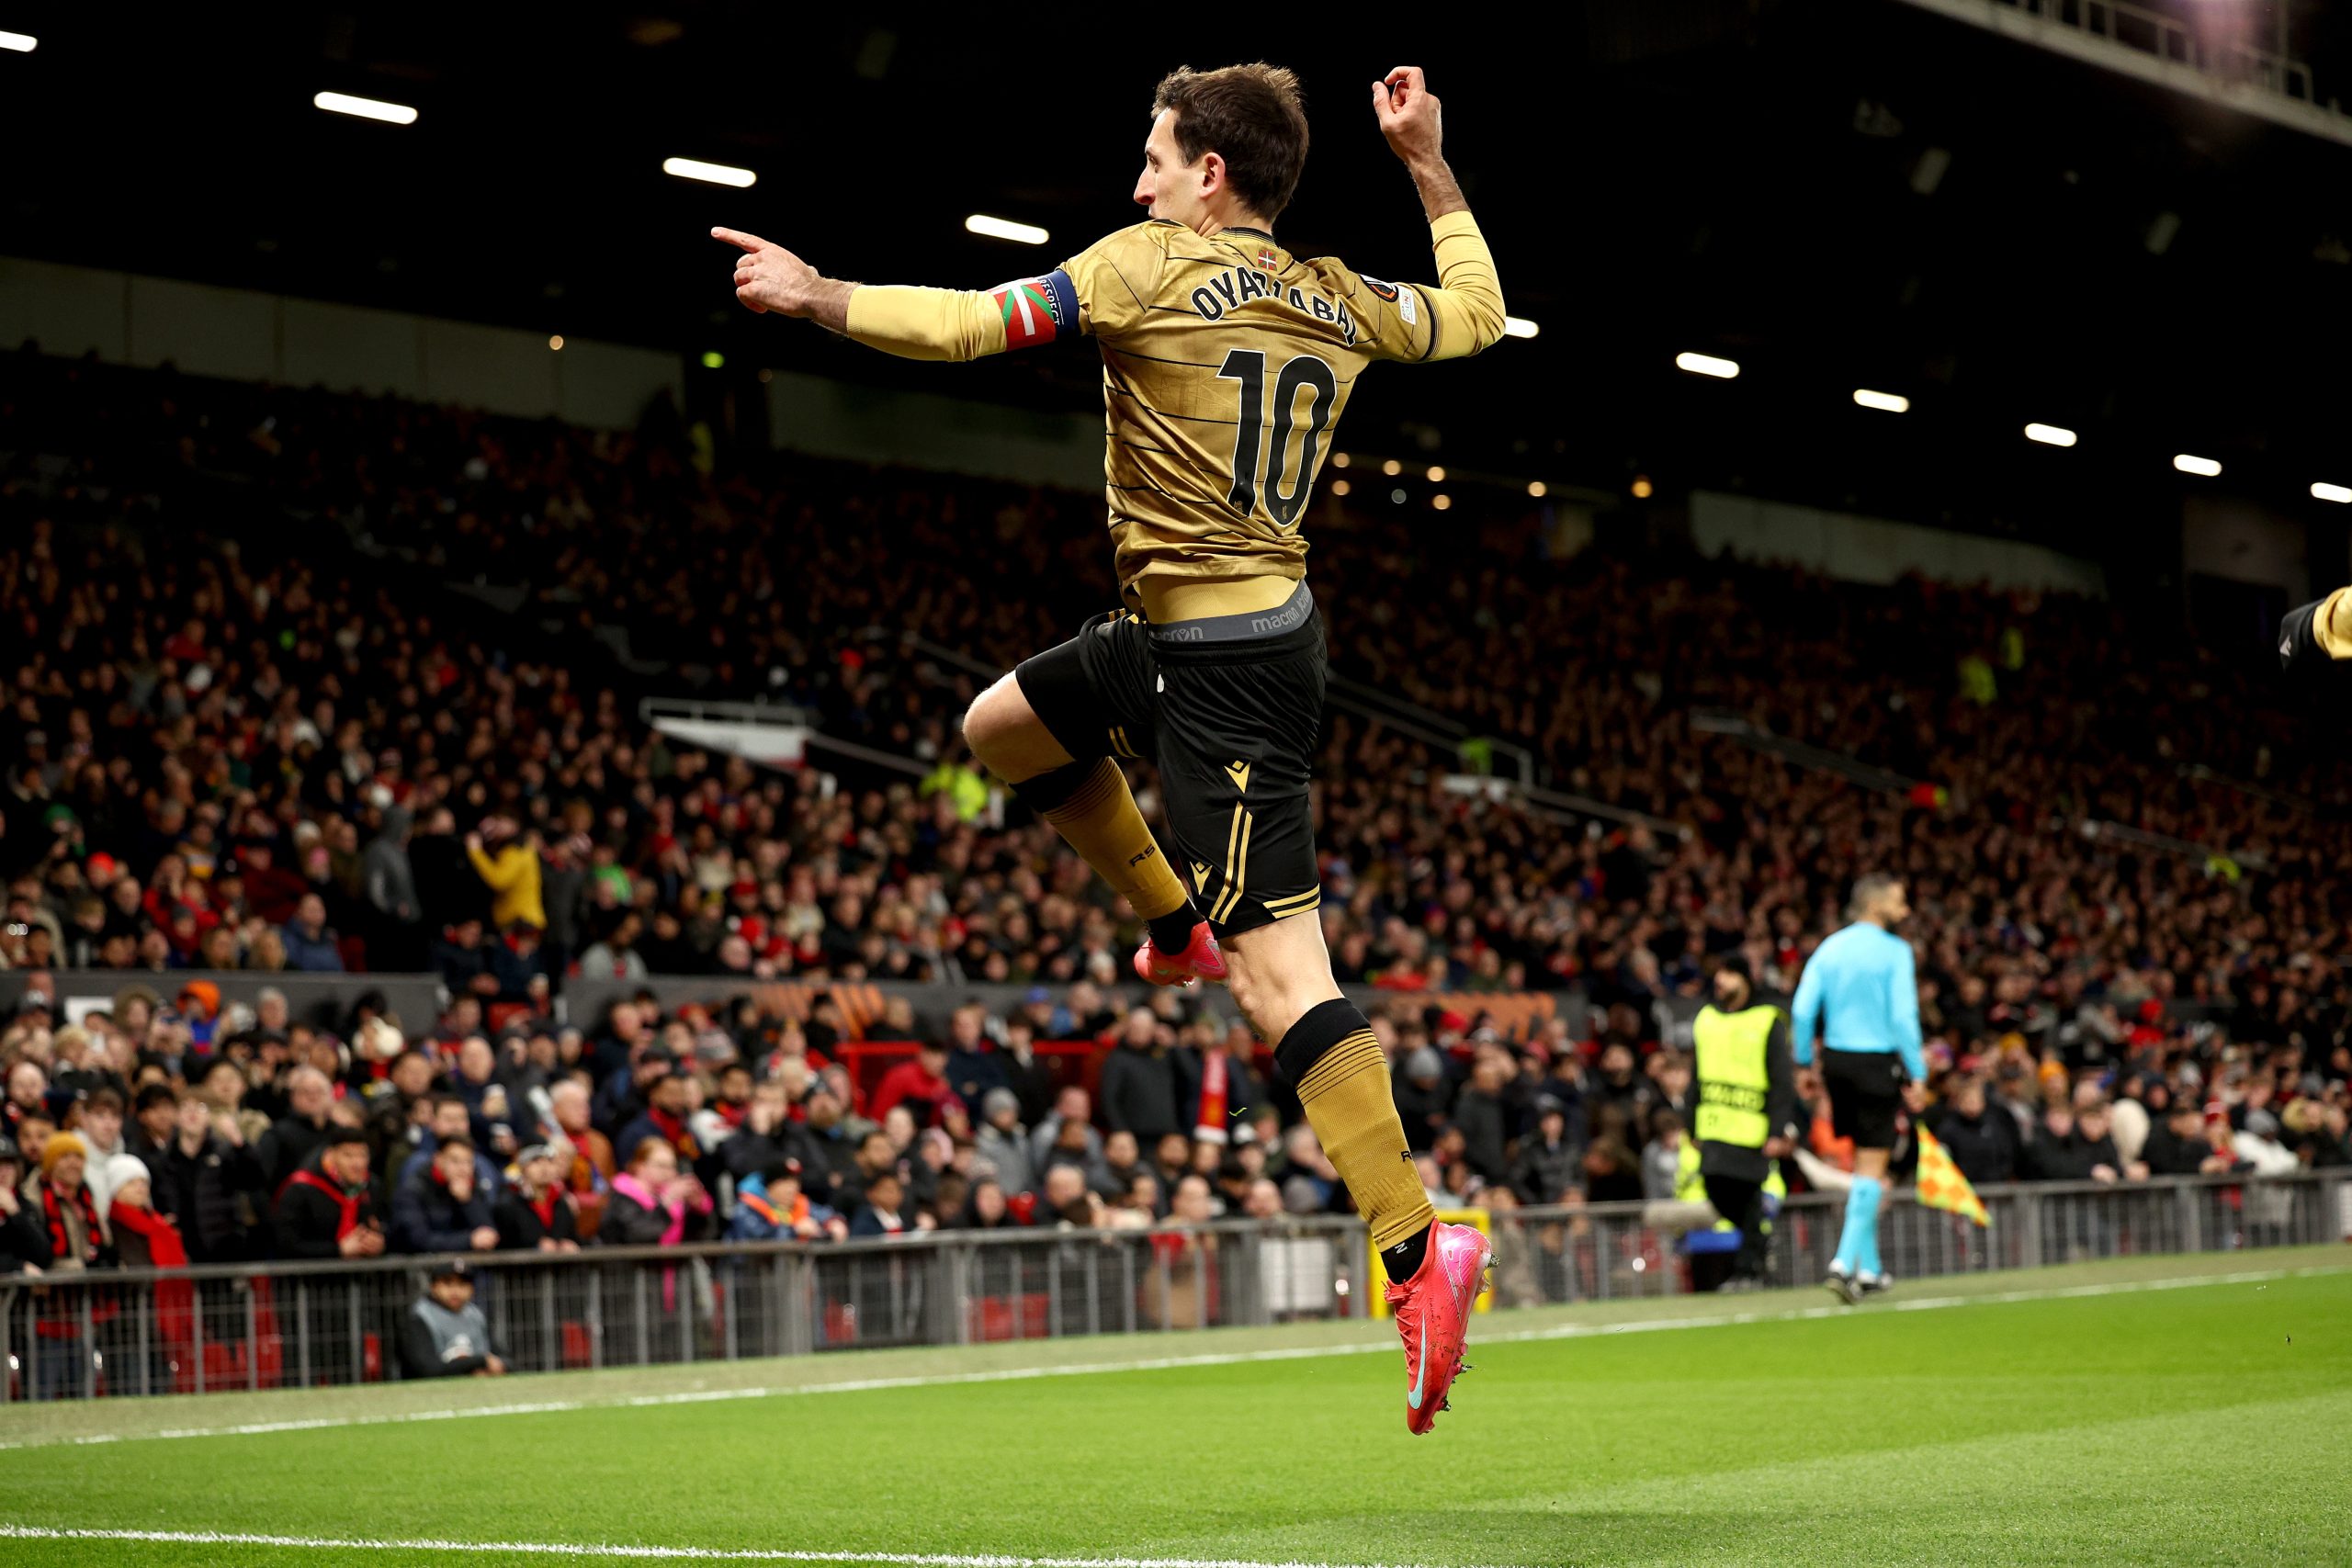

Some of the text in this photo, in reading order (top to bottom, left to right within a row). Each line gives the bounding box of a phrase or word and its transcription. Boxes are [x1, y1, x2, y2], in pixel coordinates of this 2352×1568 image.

[1216, 348, 1337, 527] 10
[1251, 607, 1300, 633] macron
[1129, 843, 1156, 867] RS
